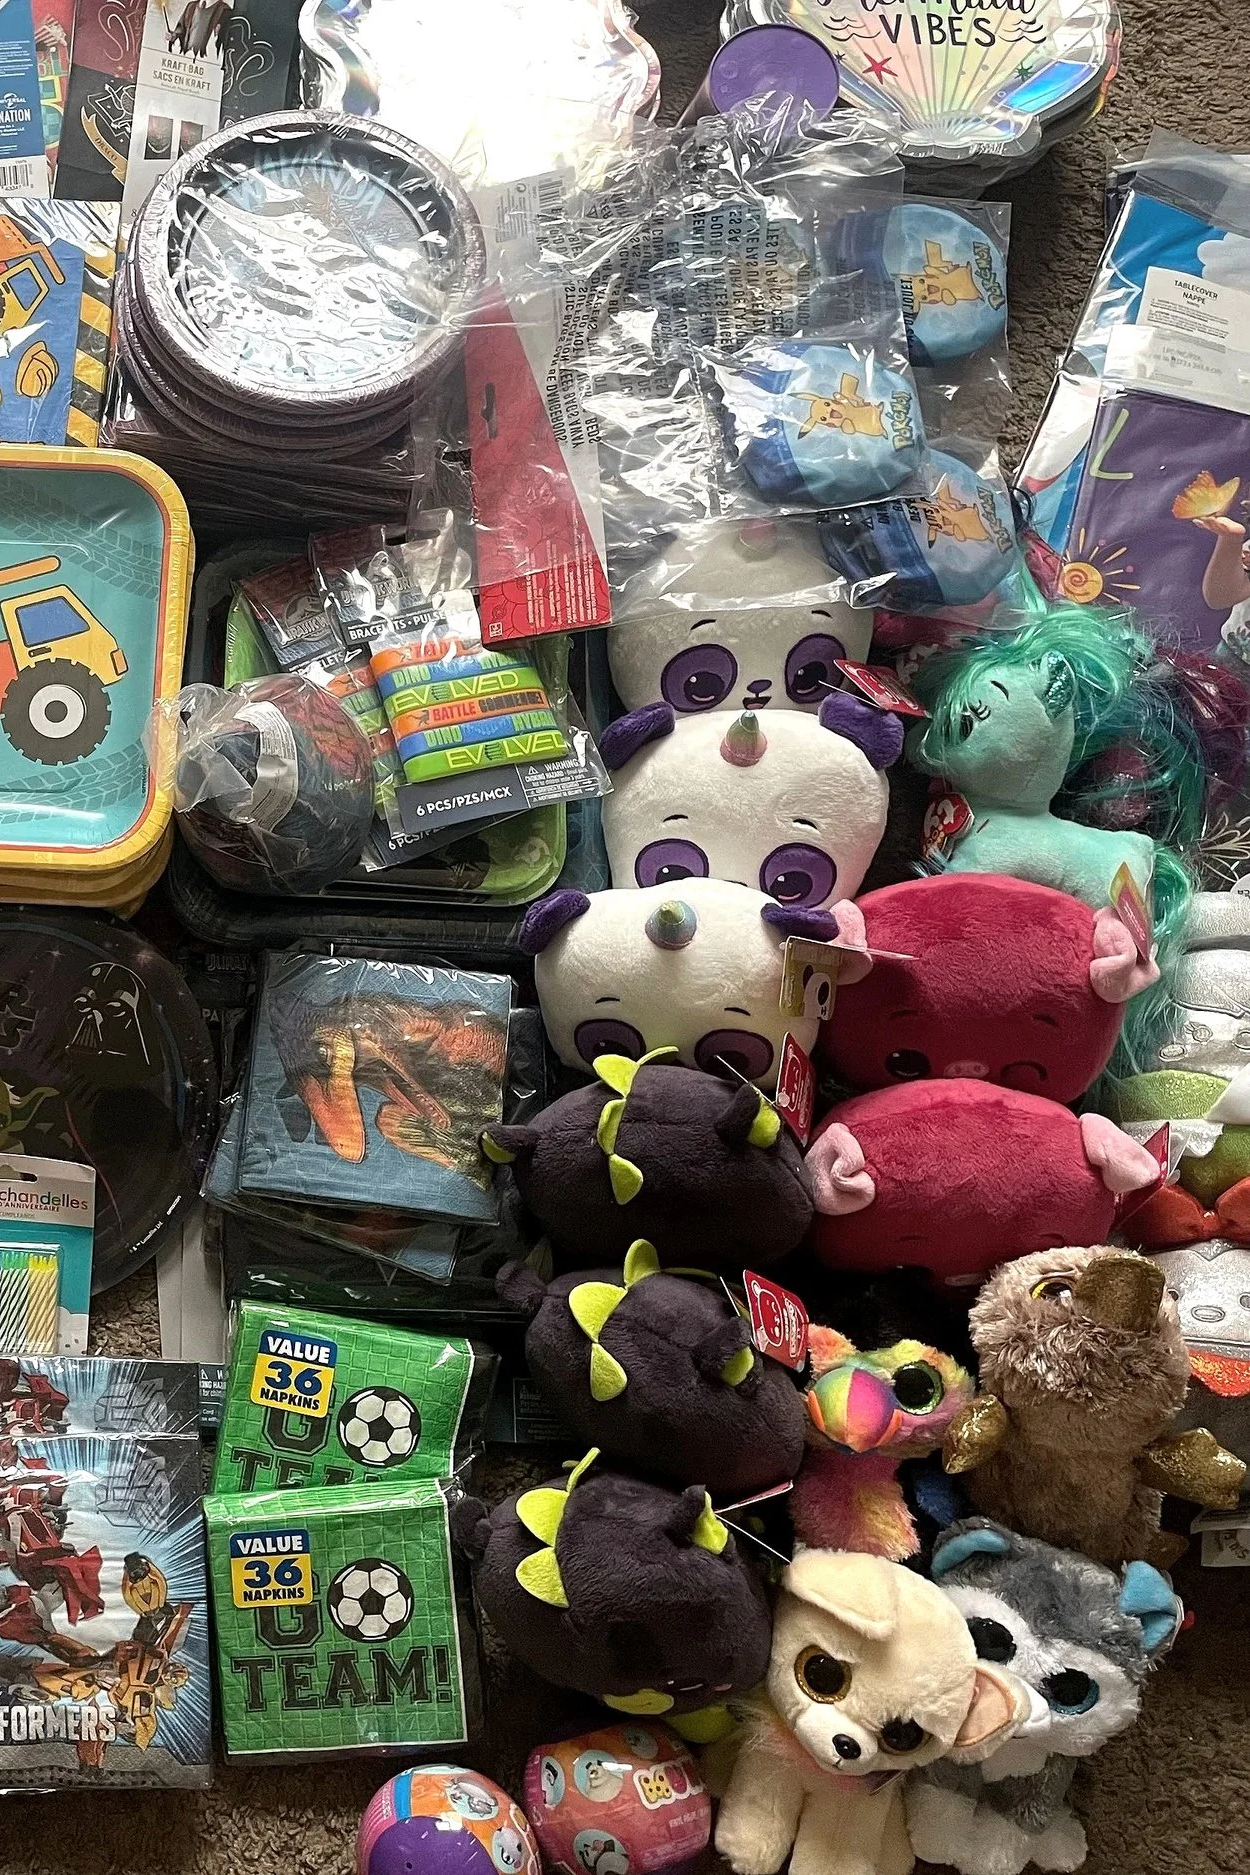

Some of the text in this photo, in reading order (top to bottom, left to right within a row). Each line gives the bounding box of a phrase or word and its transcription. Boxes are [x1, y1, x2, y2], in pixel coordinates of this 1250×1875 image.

[878, 13, 997, 47] VIBES
[161, 58, 204, 76] KRAFT BAG
[152, 71, 174, 83] SACS
[174, 75, 185, 86] EN
[185, 77, 211, 92] KRAFT
[1174, 280, 1219, 299] TABLECOVER
[1183, 292, 1206, 304] NAPPE
[392, 665, 431, 687] DINO
[432, 701, 476, 721] BATTLE
[423, 726, 462, 747] DINO
[544, 759, 579, 772] WARNING
[416, 806, 426, 818] 6
[427, 787, 513, 814] PCS/PZS/MCX
[388, 839, 397, 850] 6
[267, 1336, 331, 1364] VALUE
[264, 1361, 323, 1397] 36
[260, 1387, 320, 1410] NAPKINS
[237, 1535, 303, 1555] VALUE
[244, 1558, 302, 1588] 36
[243, 1587, 304, 1602] NAPKINS
[230, 1645, 453, 1713] TEAM!
